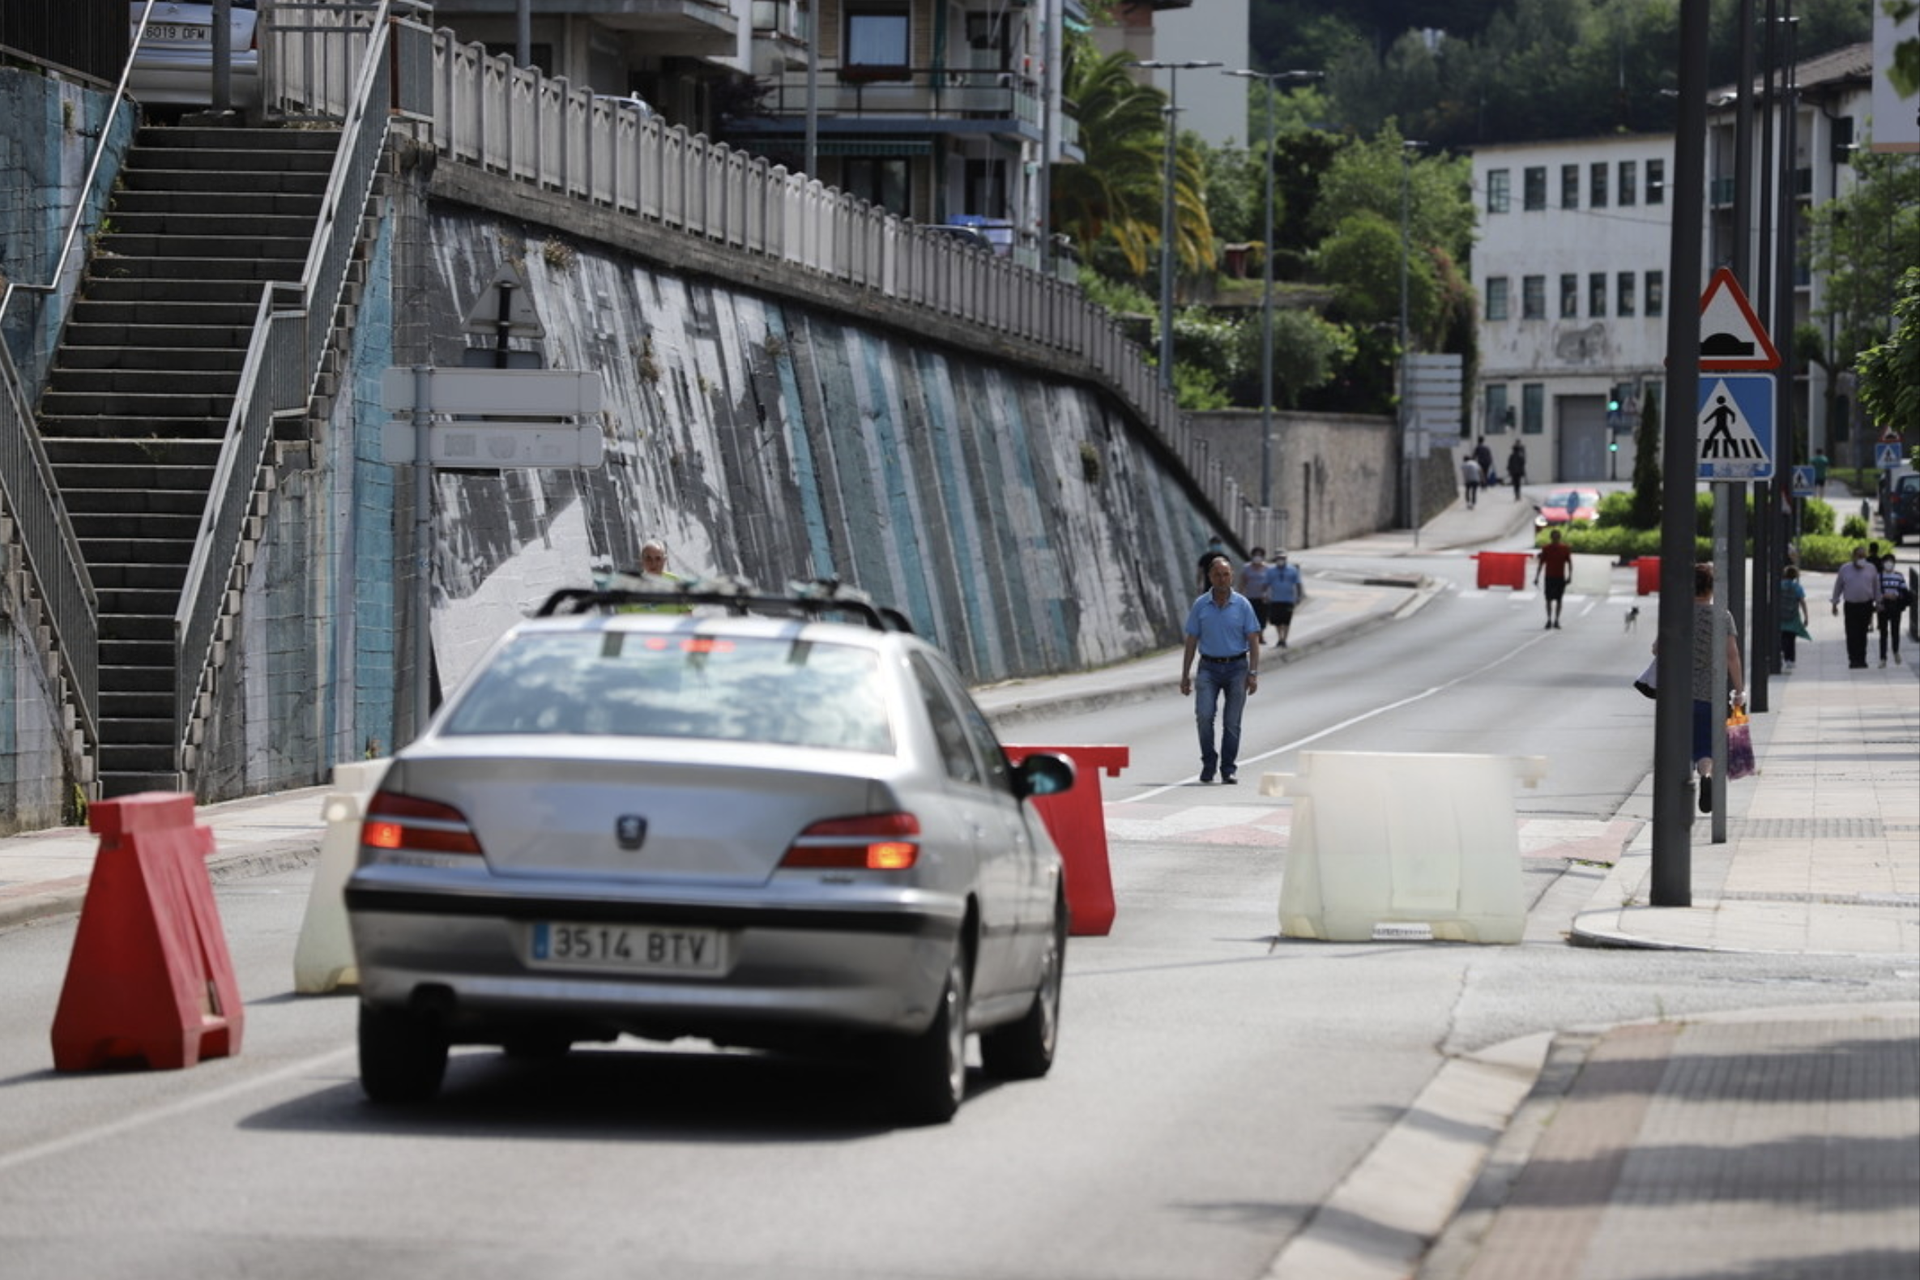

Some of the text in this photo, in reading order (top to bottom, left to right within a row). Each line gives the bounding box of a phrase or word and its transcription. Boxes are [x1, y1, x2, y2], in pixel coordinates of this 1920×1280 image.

[146, 26, 176, 39] 6019
[554, 927, 706, 965] 3514 BTV
